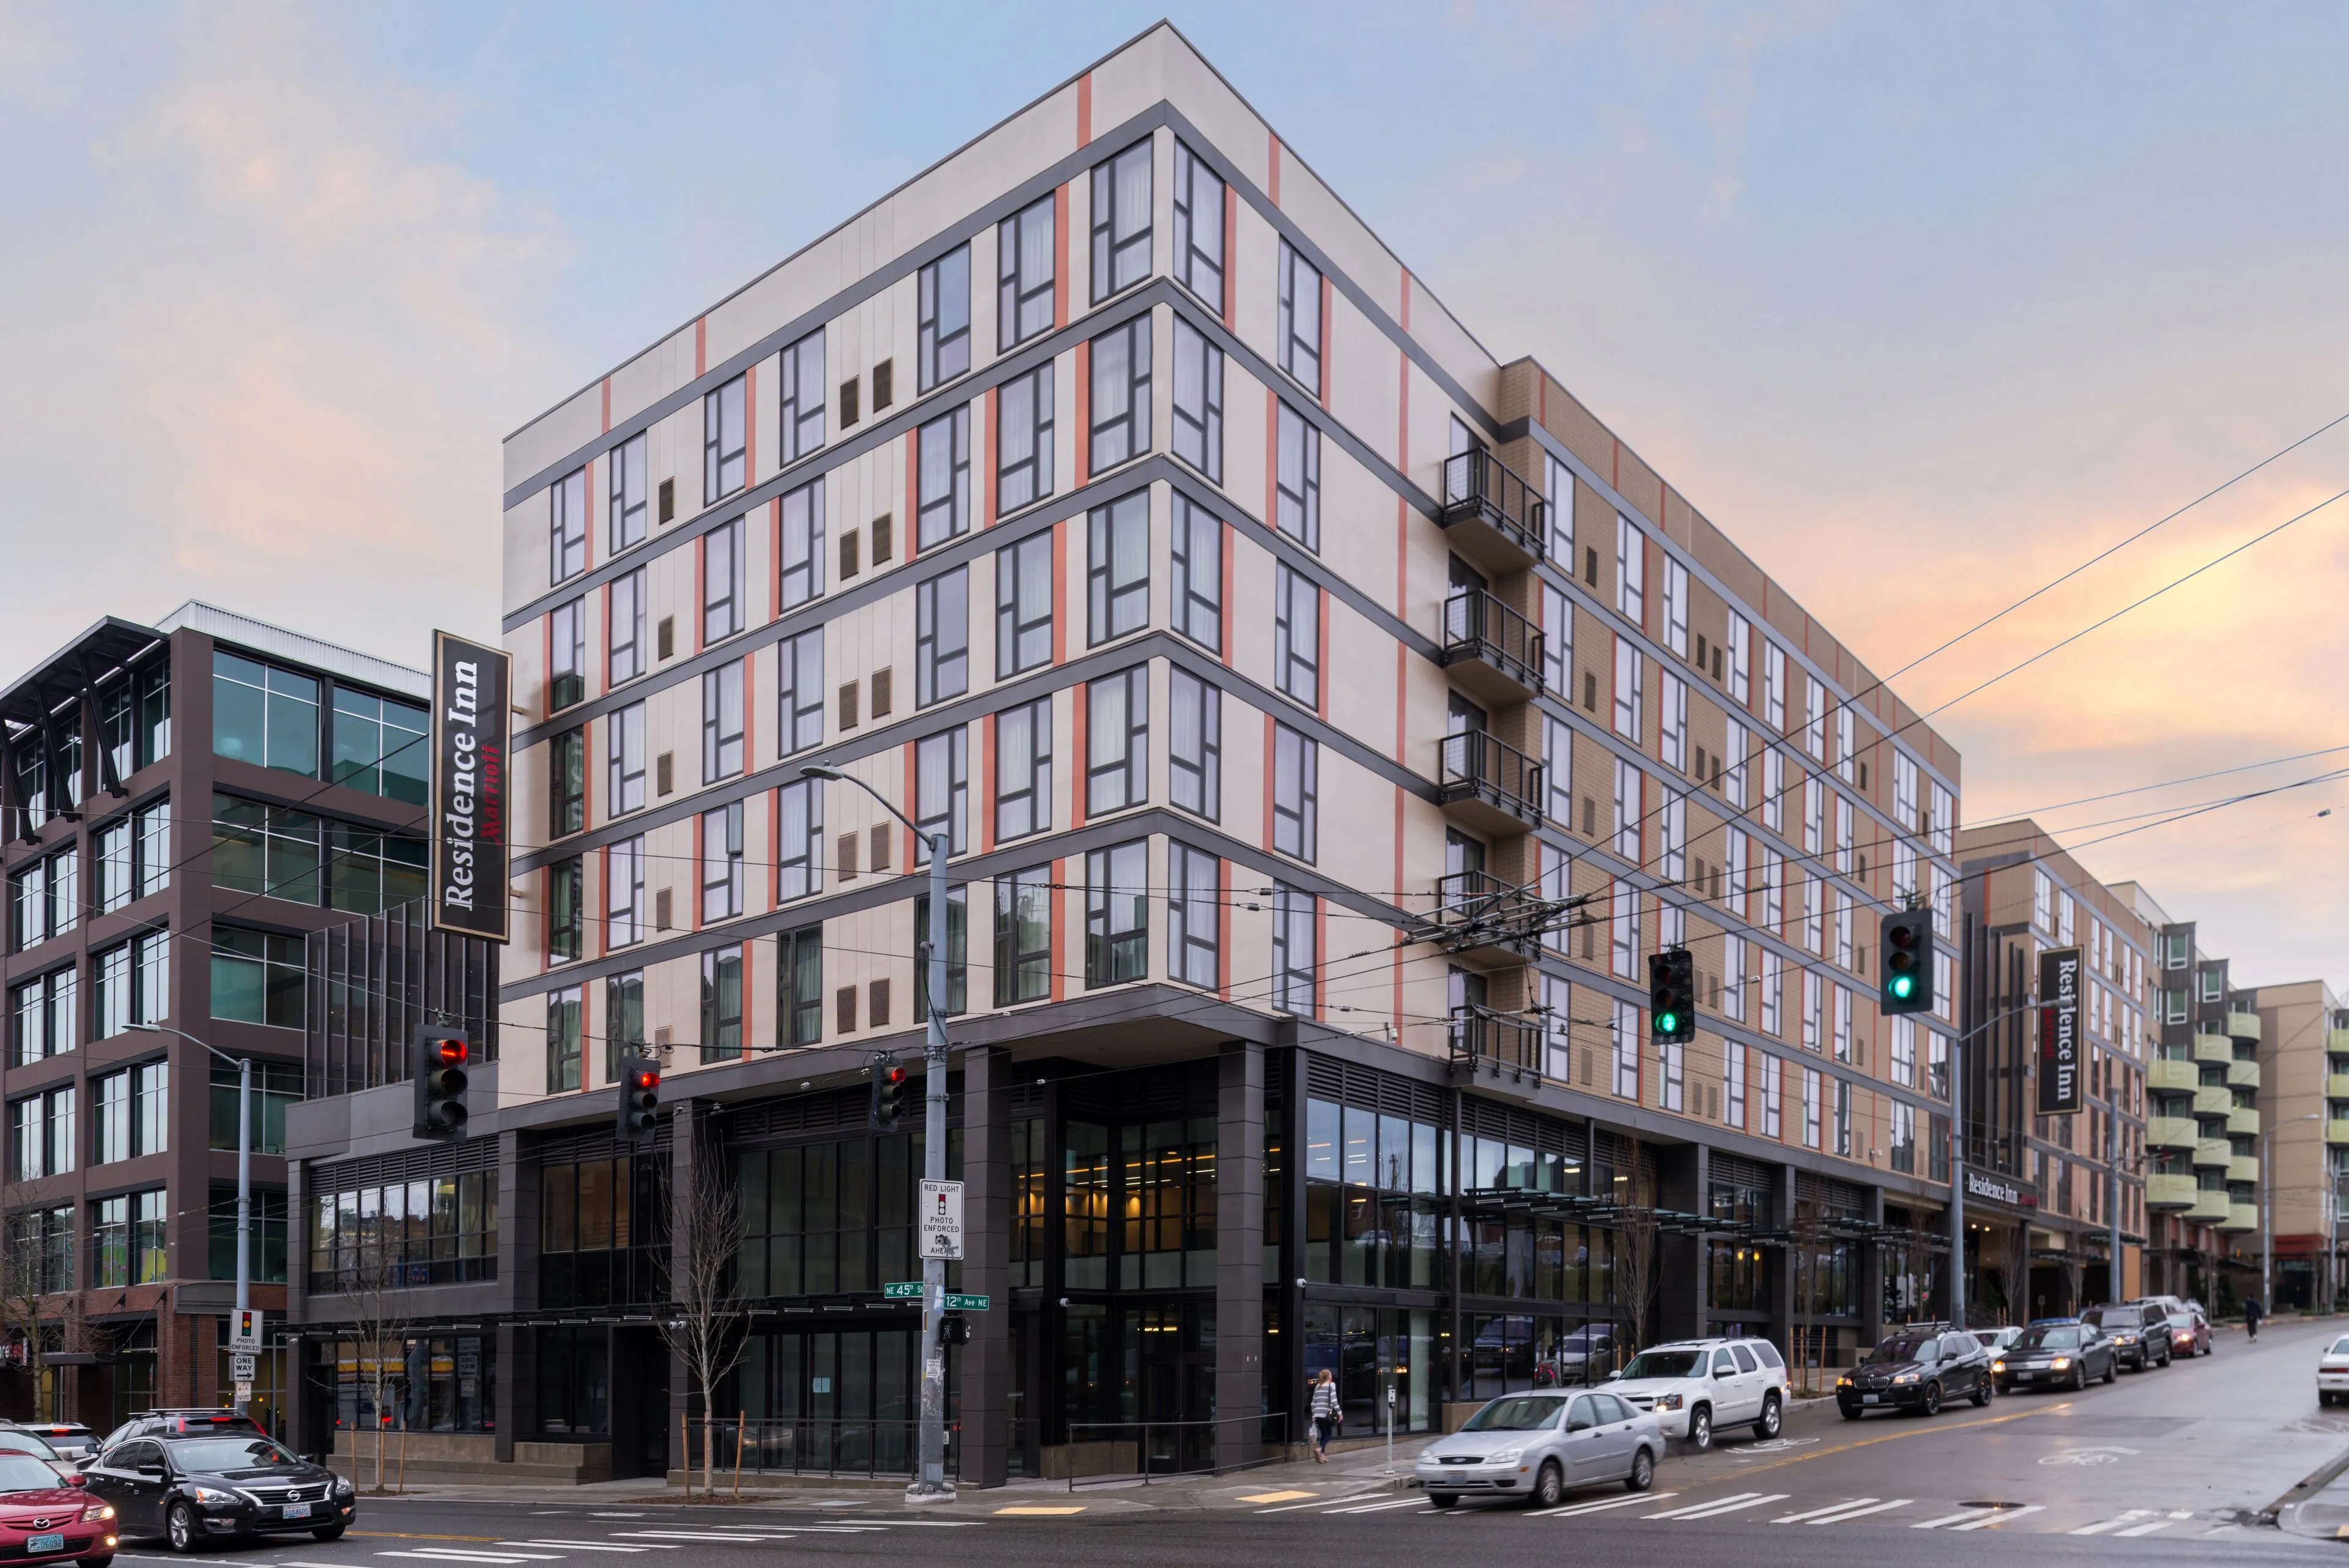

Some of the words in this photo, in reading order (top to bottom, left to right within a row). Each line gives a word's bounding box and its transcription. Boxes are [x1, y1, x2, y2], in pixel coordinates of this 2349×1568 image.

[448, 661, 477, 727] Inn
[480, 745, 502, 847] Marriott
[446, 733, 475, 912] Residence
[2058, 1063, 2076, 1101] Inn
[1969, 1173, 2005, 1201] Residence
[2005, 1183, 2017, 1204] Inn
[924, 1224, 959, 1233] ENFORCED
[946, 1296, 962, 1307] 12th
